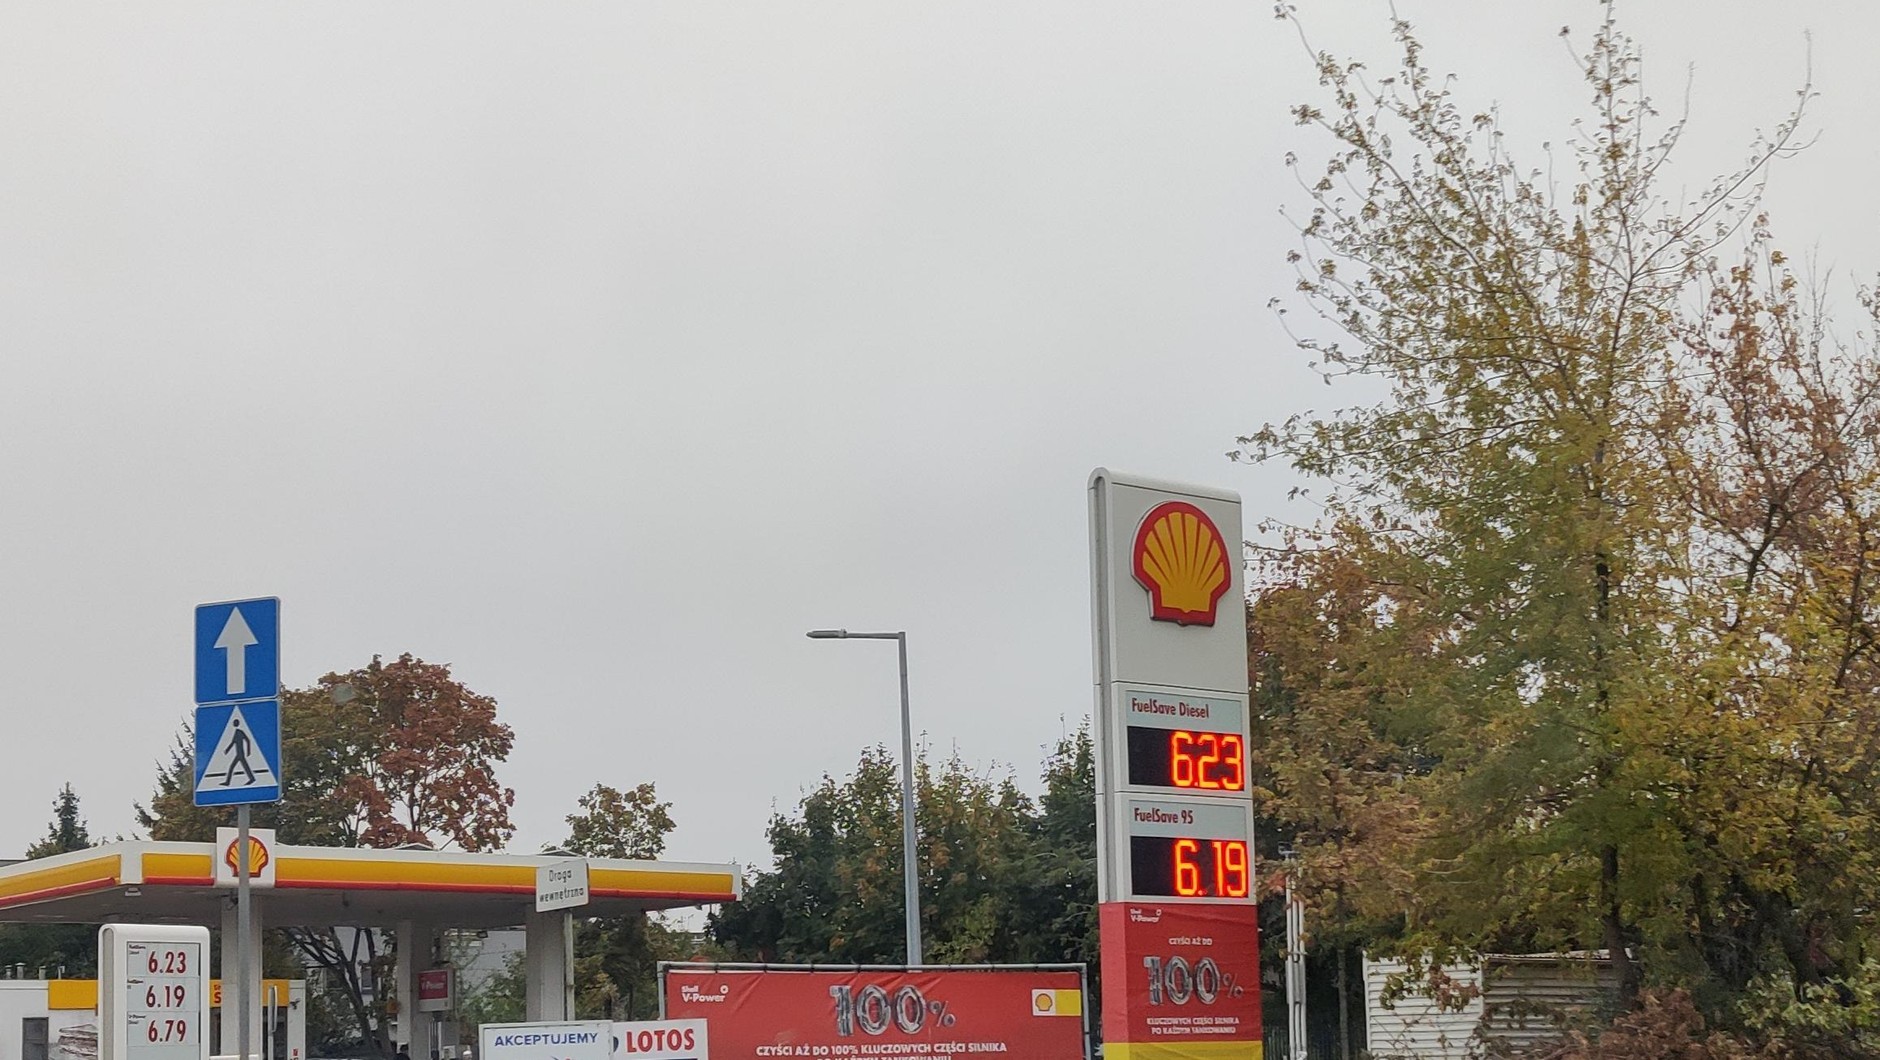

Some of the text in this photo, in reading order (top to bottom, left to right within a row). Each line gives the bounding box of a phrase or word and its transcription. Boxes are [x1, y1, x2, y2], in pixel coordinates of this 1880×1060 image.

[1131, 697, 1209, 718] FuelSave Diesel
[1171, 729, 1244, 791] 6.23
[1134, 807, 1194, 824] FuelSave 95
[549, 869, 572, 883] Droga
[1174, 838, 1248, 898] 6.19
[148, 950, 187, 974] 6.23
[145, 984, 186, 1008] 6.19
[682, 992, 726, 1003] V-Power
[148, 1019, 187, 1043] 6.79
[494, 1032, 598, 1047] AKCEPTUJEMY
[626, 1028, 695, 1053] LOTOS
[756, 1041, 1008, 1056] CZYŚCI AŻ DO 100% KLUCZOWYCH CZĘŚCI SILNIKA
